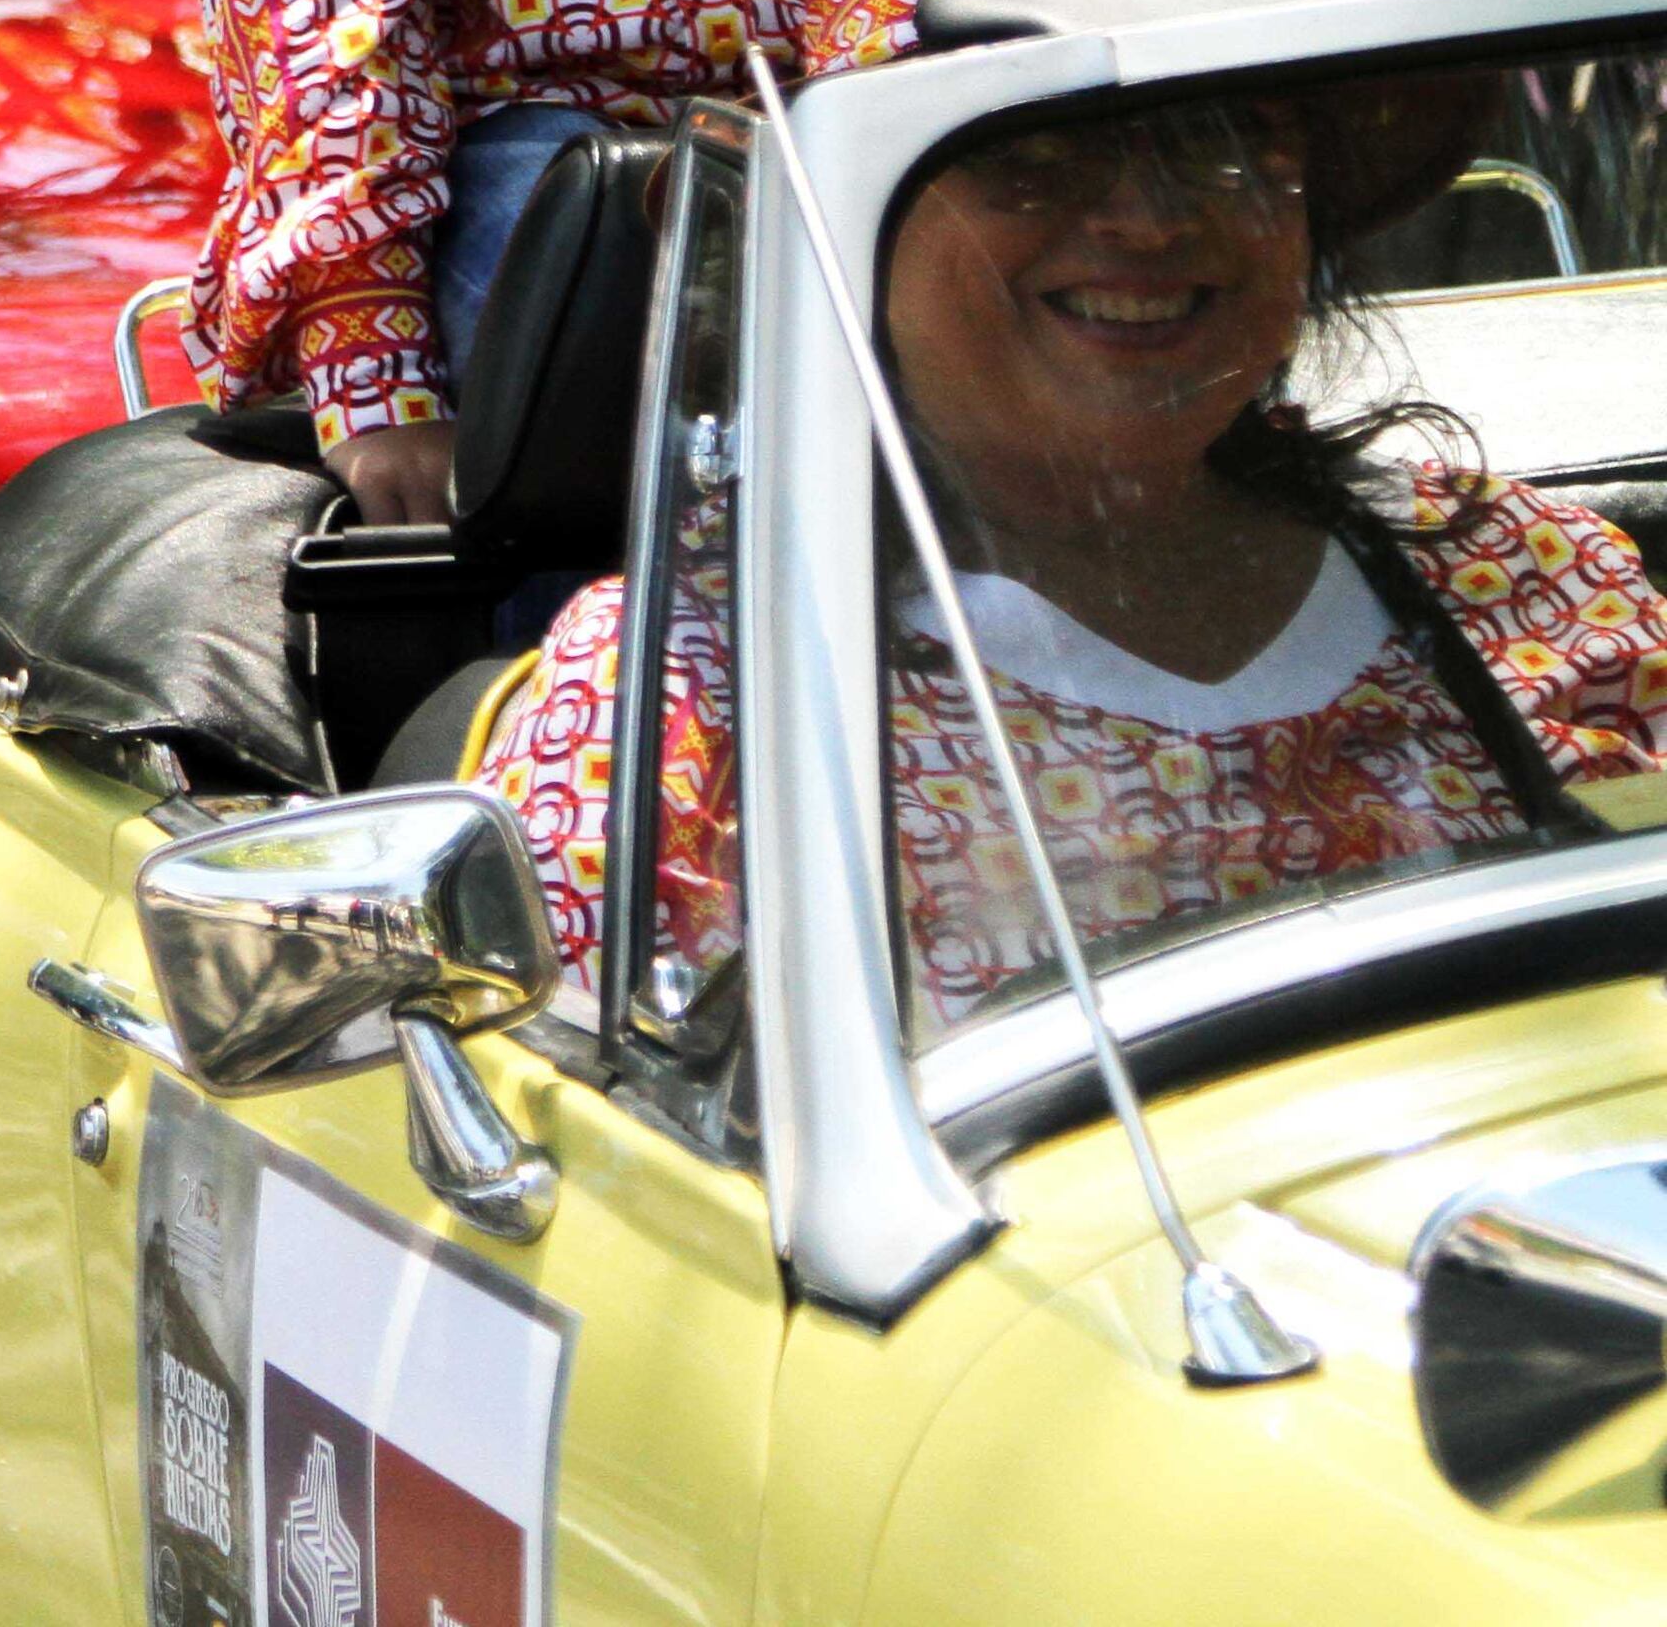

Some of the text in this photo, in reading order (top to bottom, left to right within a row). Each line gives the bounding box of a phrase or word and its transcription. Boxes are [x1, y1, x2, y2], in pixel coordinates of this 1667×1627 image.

[162, 1351, 230, 1433] PROGRESO
[164, 1397, 231, 1498] SOBRE
[166, 1457, 232, 1557] RUEDAS
